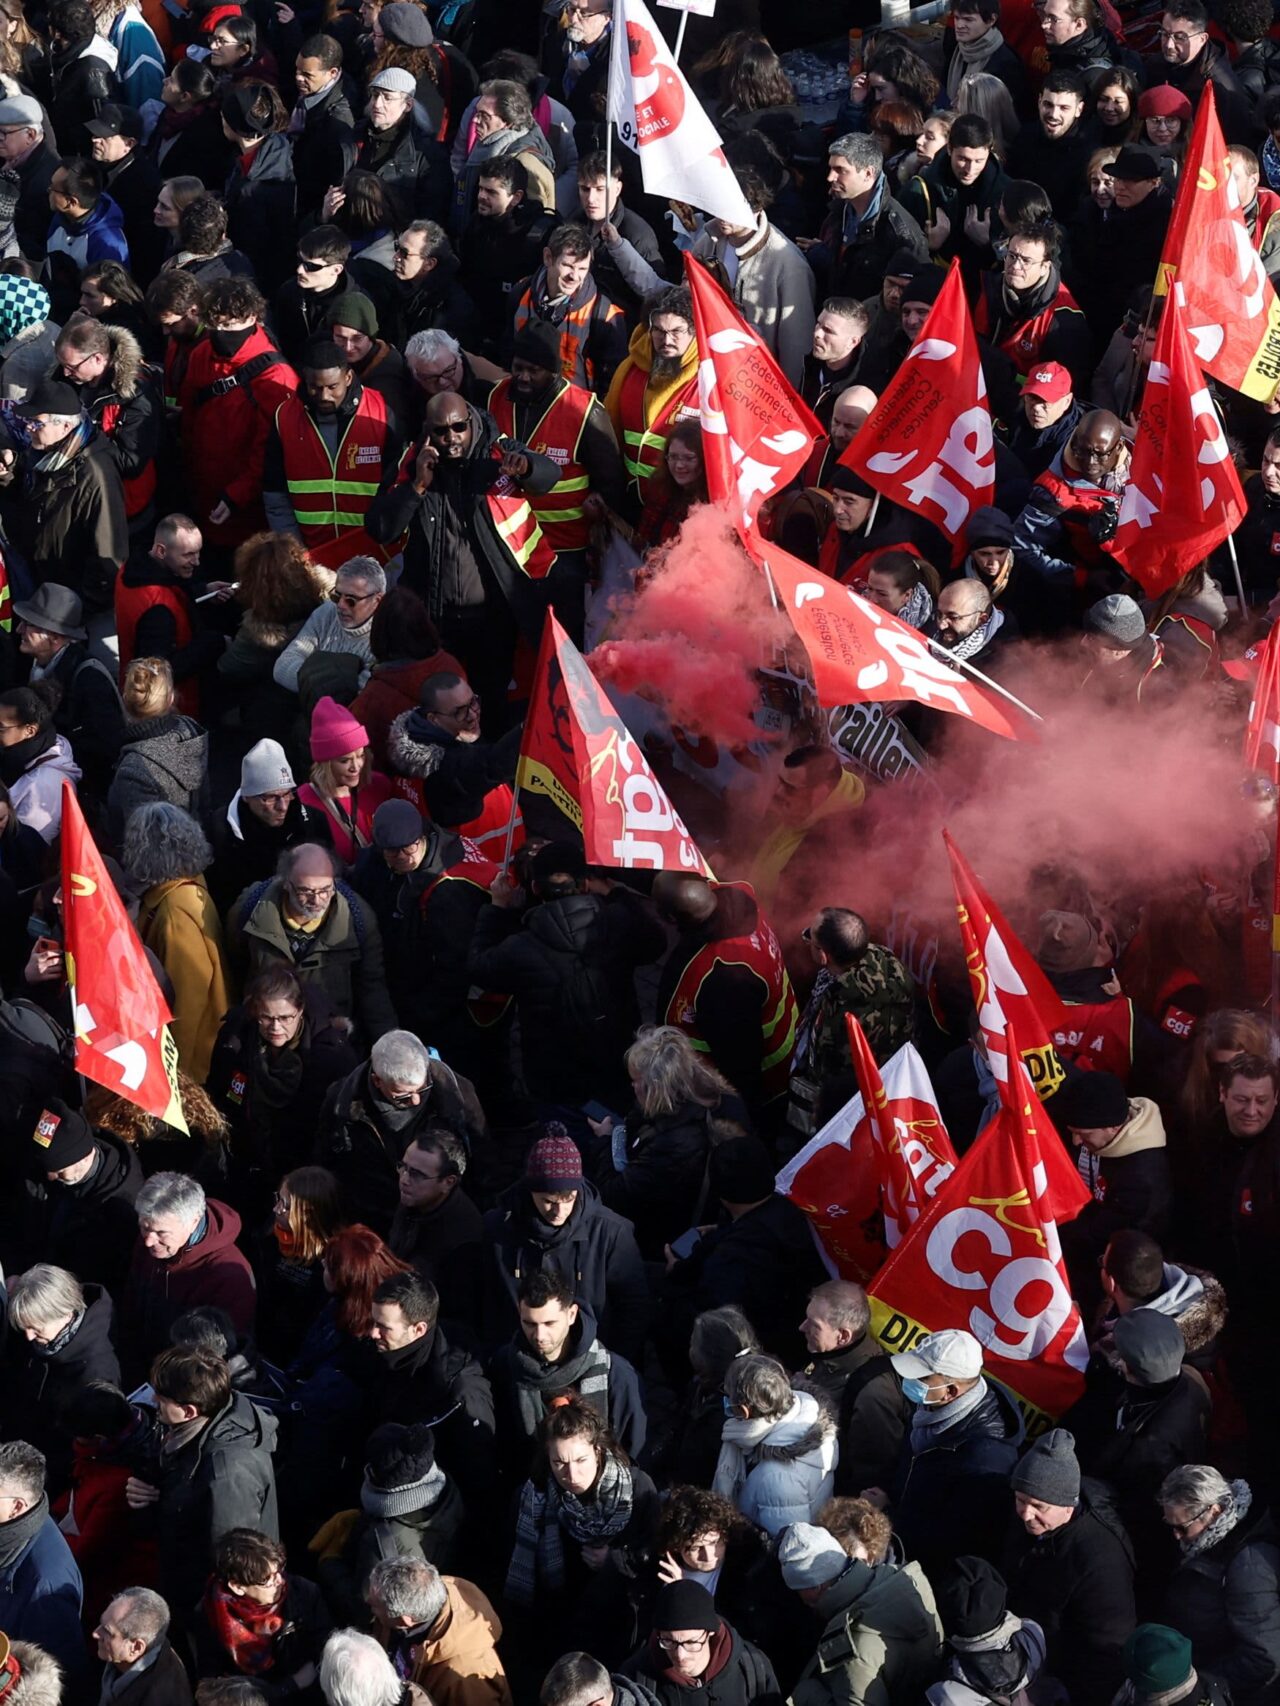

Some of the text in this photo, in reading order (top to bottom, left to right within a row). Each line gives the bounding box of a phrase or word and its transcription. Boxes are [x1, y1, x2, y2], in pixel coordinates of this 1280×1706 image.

[639, 116, 670, 137] OCIALE
[725, 382, 773, 425] Services
[736, 369, 794, 423] Commerce
[1166, 1016, 1192, 1036] cgt
